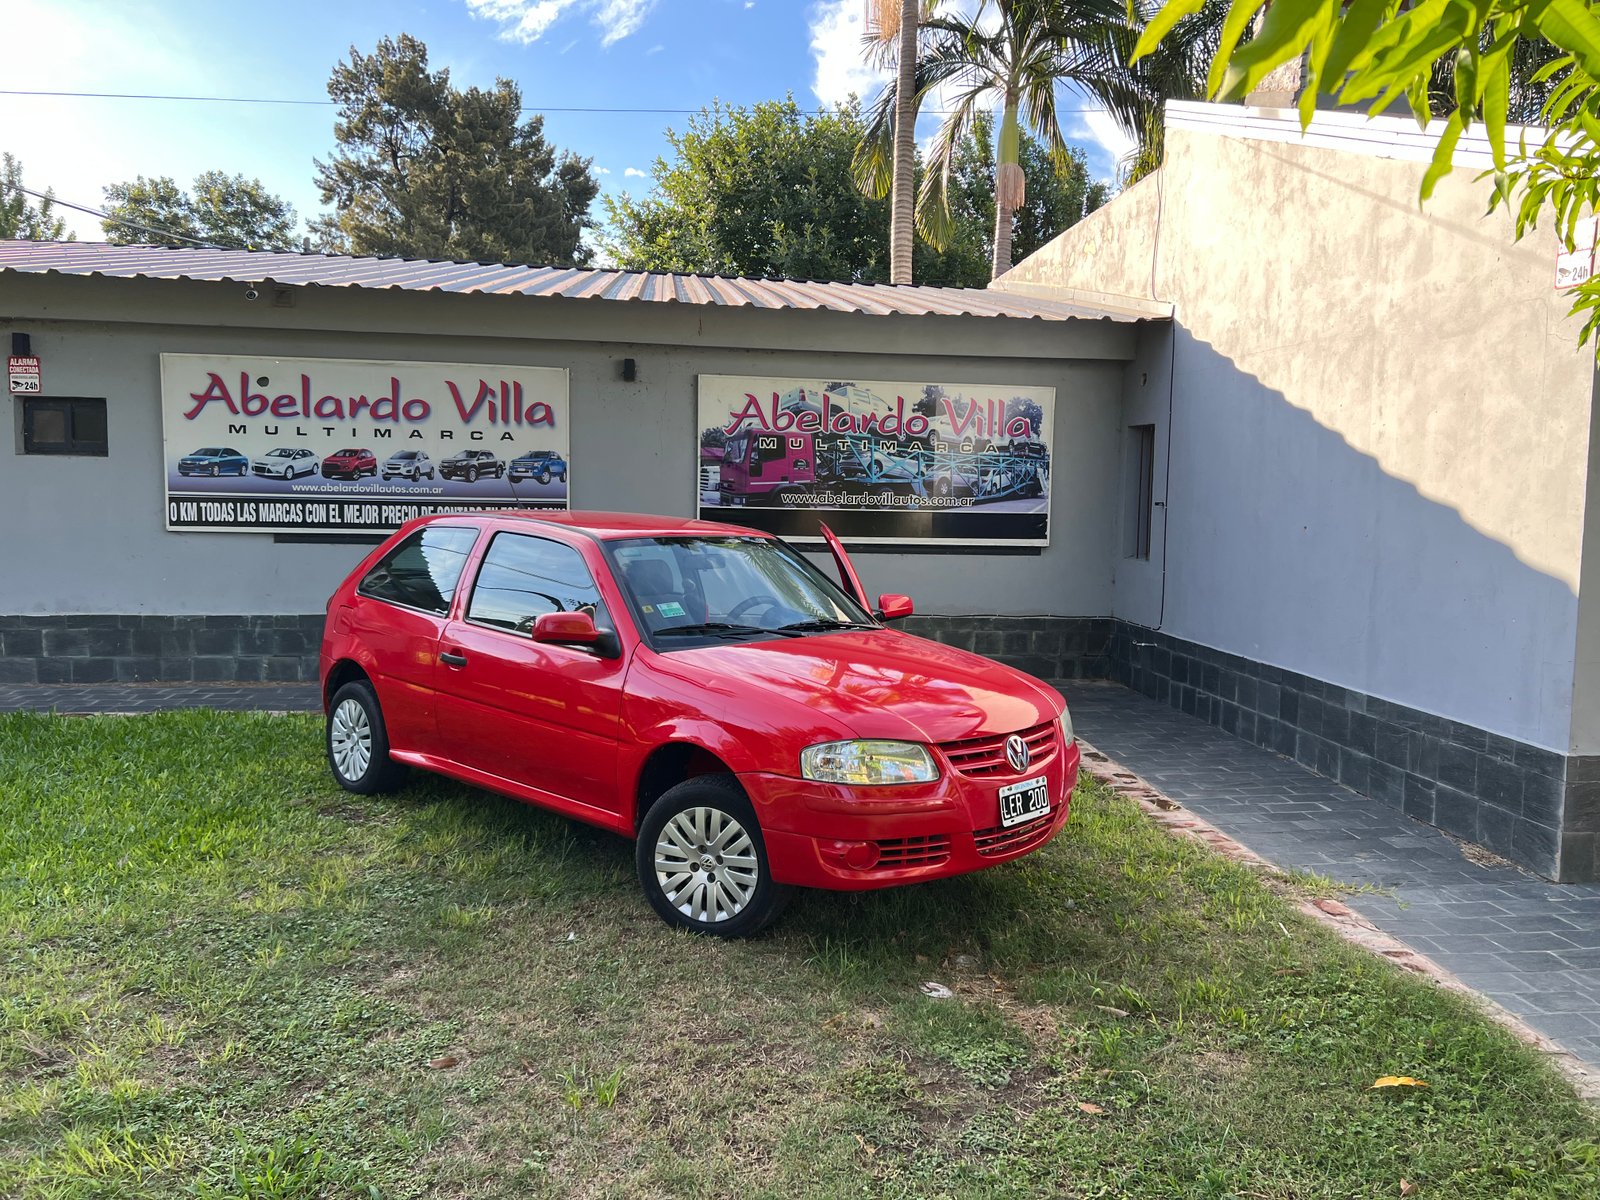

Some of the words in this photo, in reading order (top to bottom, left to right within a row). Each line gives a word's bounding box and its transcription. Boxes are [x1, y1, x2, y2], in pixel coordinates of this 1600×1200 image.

[10, 358, 38, 366] ALARMA
[24, 381, 38, 390] 24h
[183, 372, 431, 422] Abelardo
[444, 379, 555, 426] Villa
[724, 391, 929, 437] Abelardo
[941, 397, 1033, 440] Villa
[228, 424, 514, 441] MULTIMARCA
[758, 436, 1000, 454] MULTIMARCA
[291, 482, 444, 495] www.abelardovillautos.com.ar
[780, 490, 976, 508] www.abelardovillautos.com.ar
[180, 502, 198, 522] KM
[200, 502, 234, 522] TODAS
[237, 503, 256, 522] LAS
[258, 503, 303, 523] MARCAS
[305, 503, 326, 523] CON
[329, 504, 341, 523] EL
[343, 504, 379, 524] MEJOR
[381, 505, 419, 524] PRECIO
[1002, 793, 1024, 819] LER
[1028, 786, 1048, 811] 200
